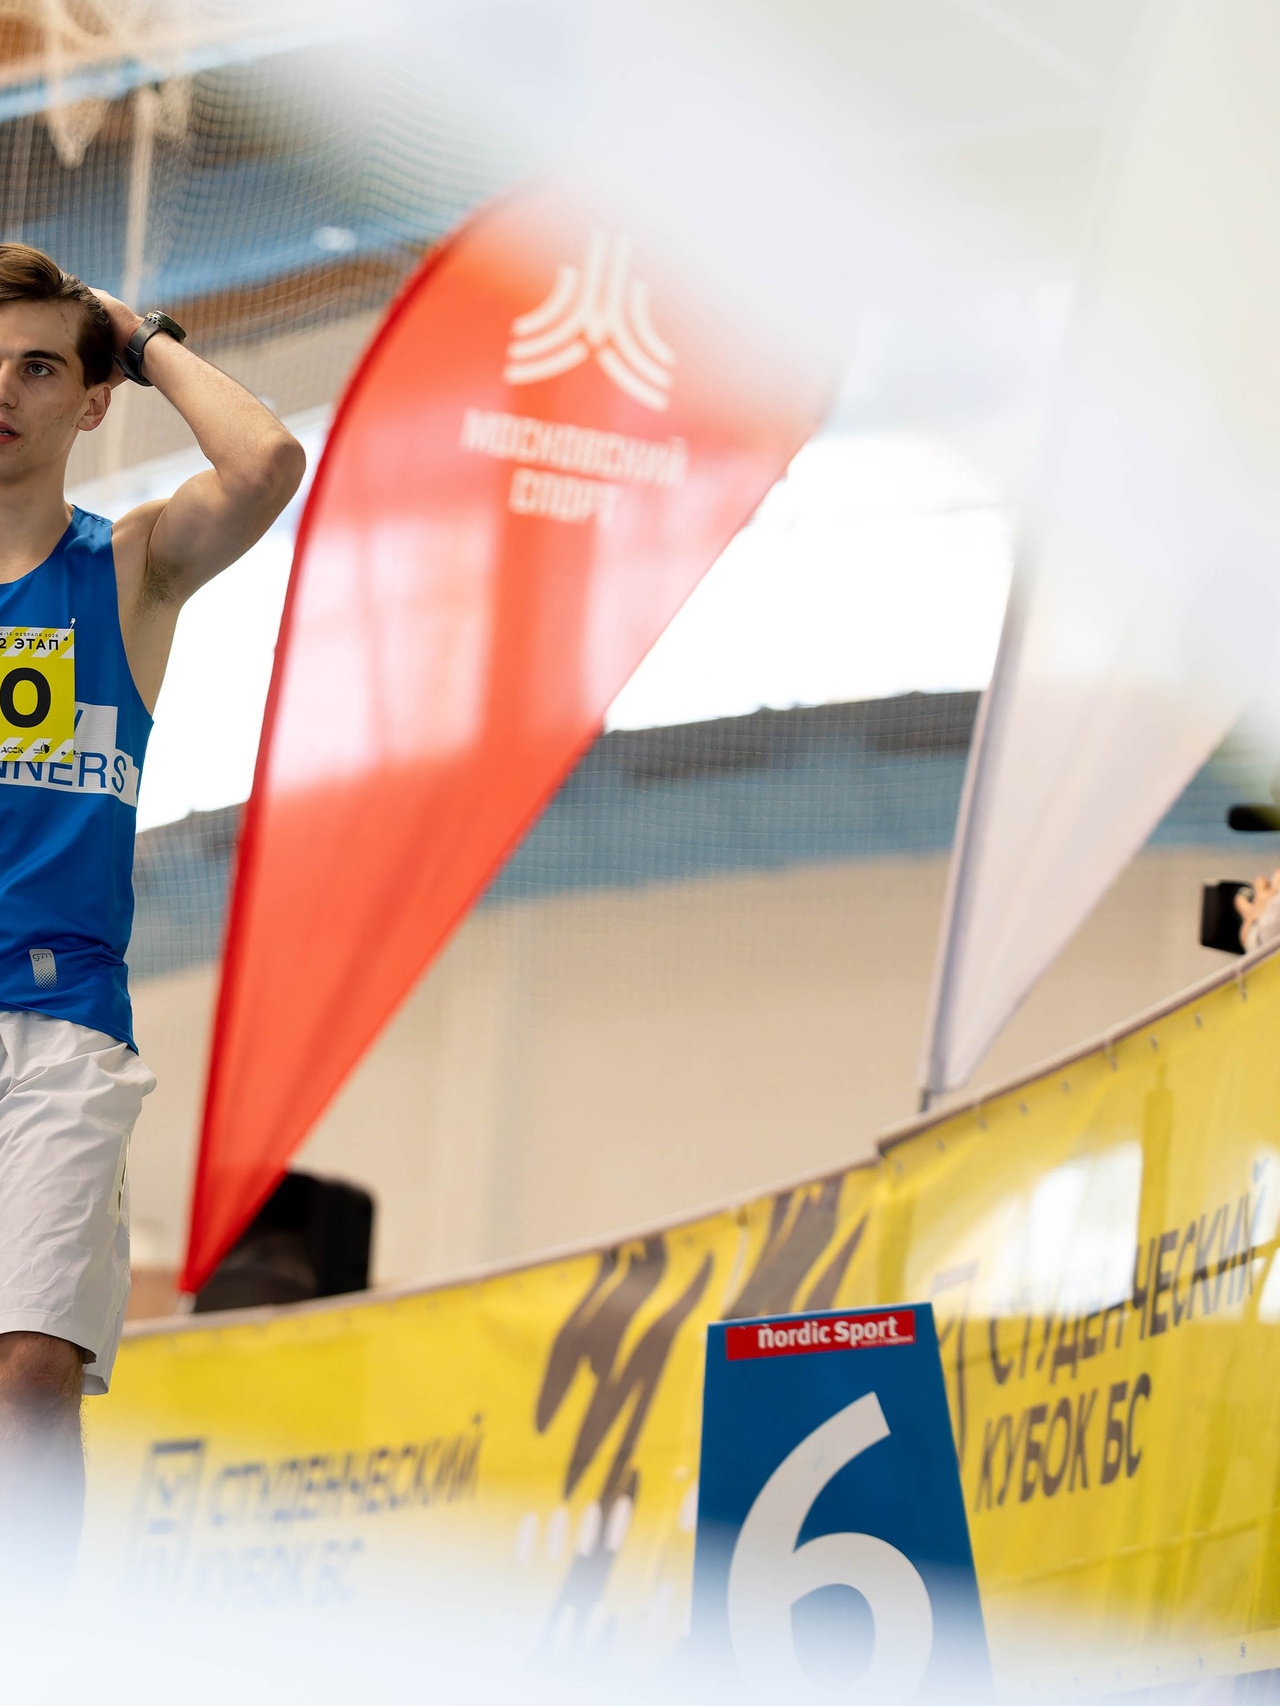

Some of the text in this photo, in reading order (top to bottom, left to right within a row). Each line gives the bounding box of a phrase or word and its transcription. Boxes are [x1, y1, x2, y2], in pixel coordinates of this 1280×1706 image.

[14, 638, 59, 651] ЭТАП
[833, 1316, 899, 1347] Sport
[974, 1373, 1152, 1513] КУБОК БС
[726, 1391, 935, 1704] 6
